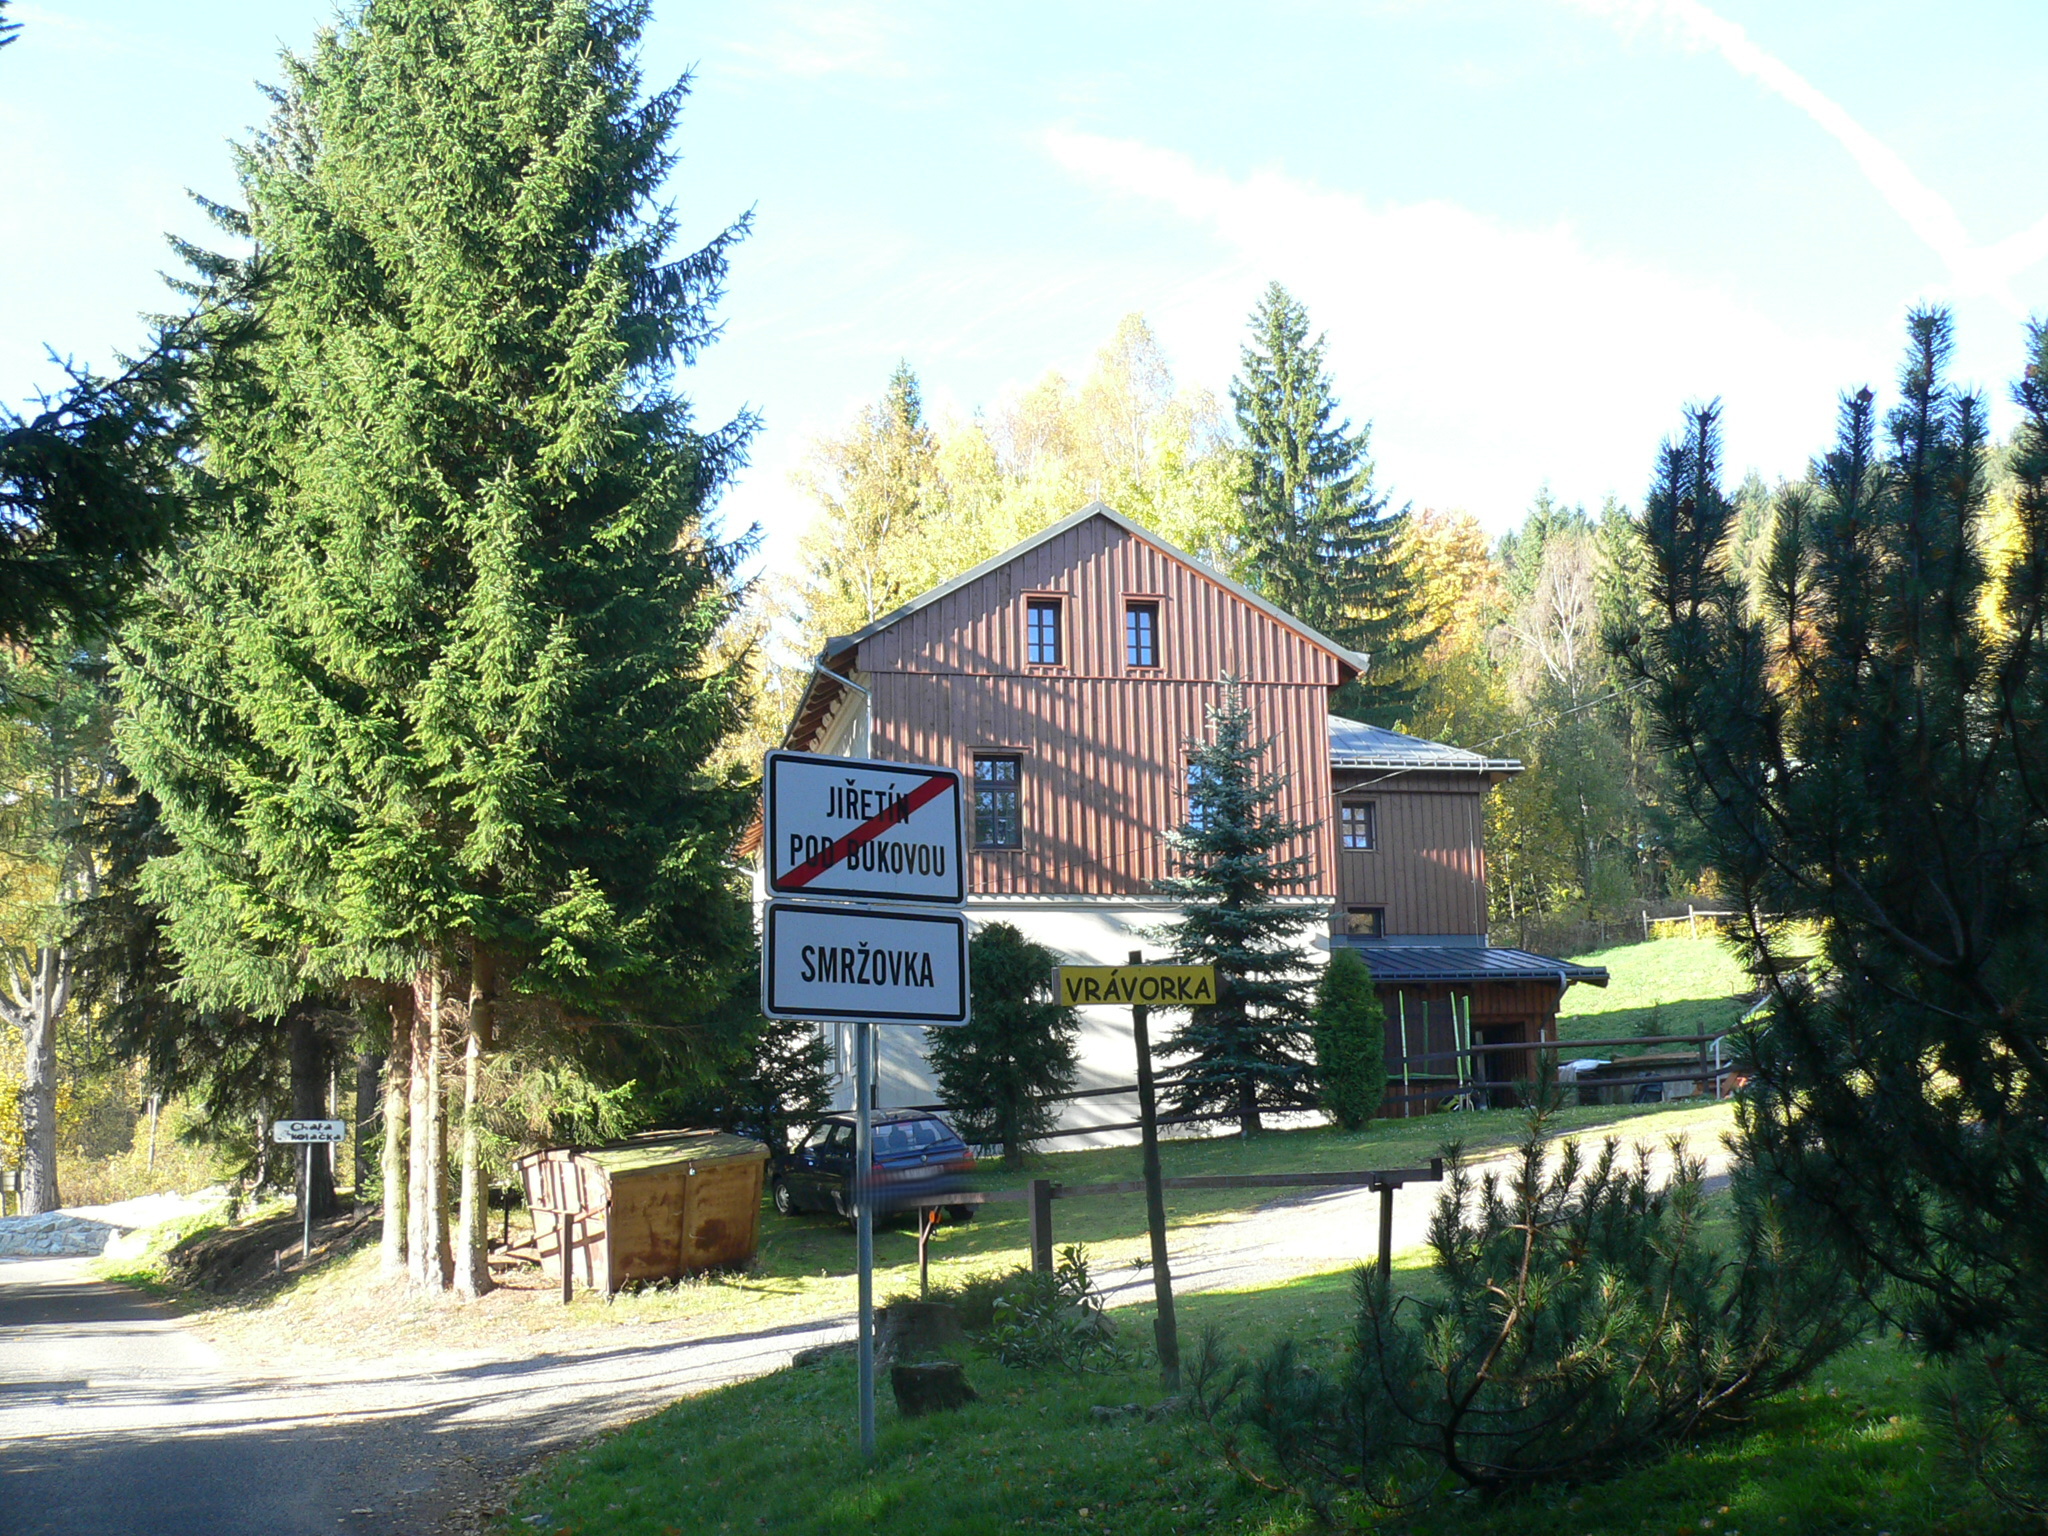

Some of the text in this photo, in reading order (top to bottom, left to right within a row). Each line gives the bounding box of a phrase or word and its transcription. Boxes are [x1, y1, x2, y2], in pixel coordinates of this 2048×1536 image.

[826, 778, 910, 824] JIŘETÍN
[790, 833, 945, 877] POD BUKOVOU
[801, 941, 935, 988] SMRŽOVKA
[1065, 968, 1211, 1002] VRÁVORKA
[290, 1122, 332, 1131] Chata
